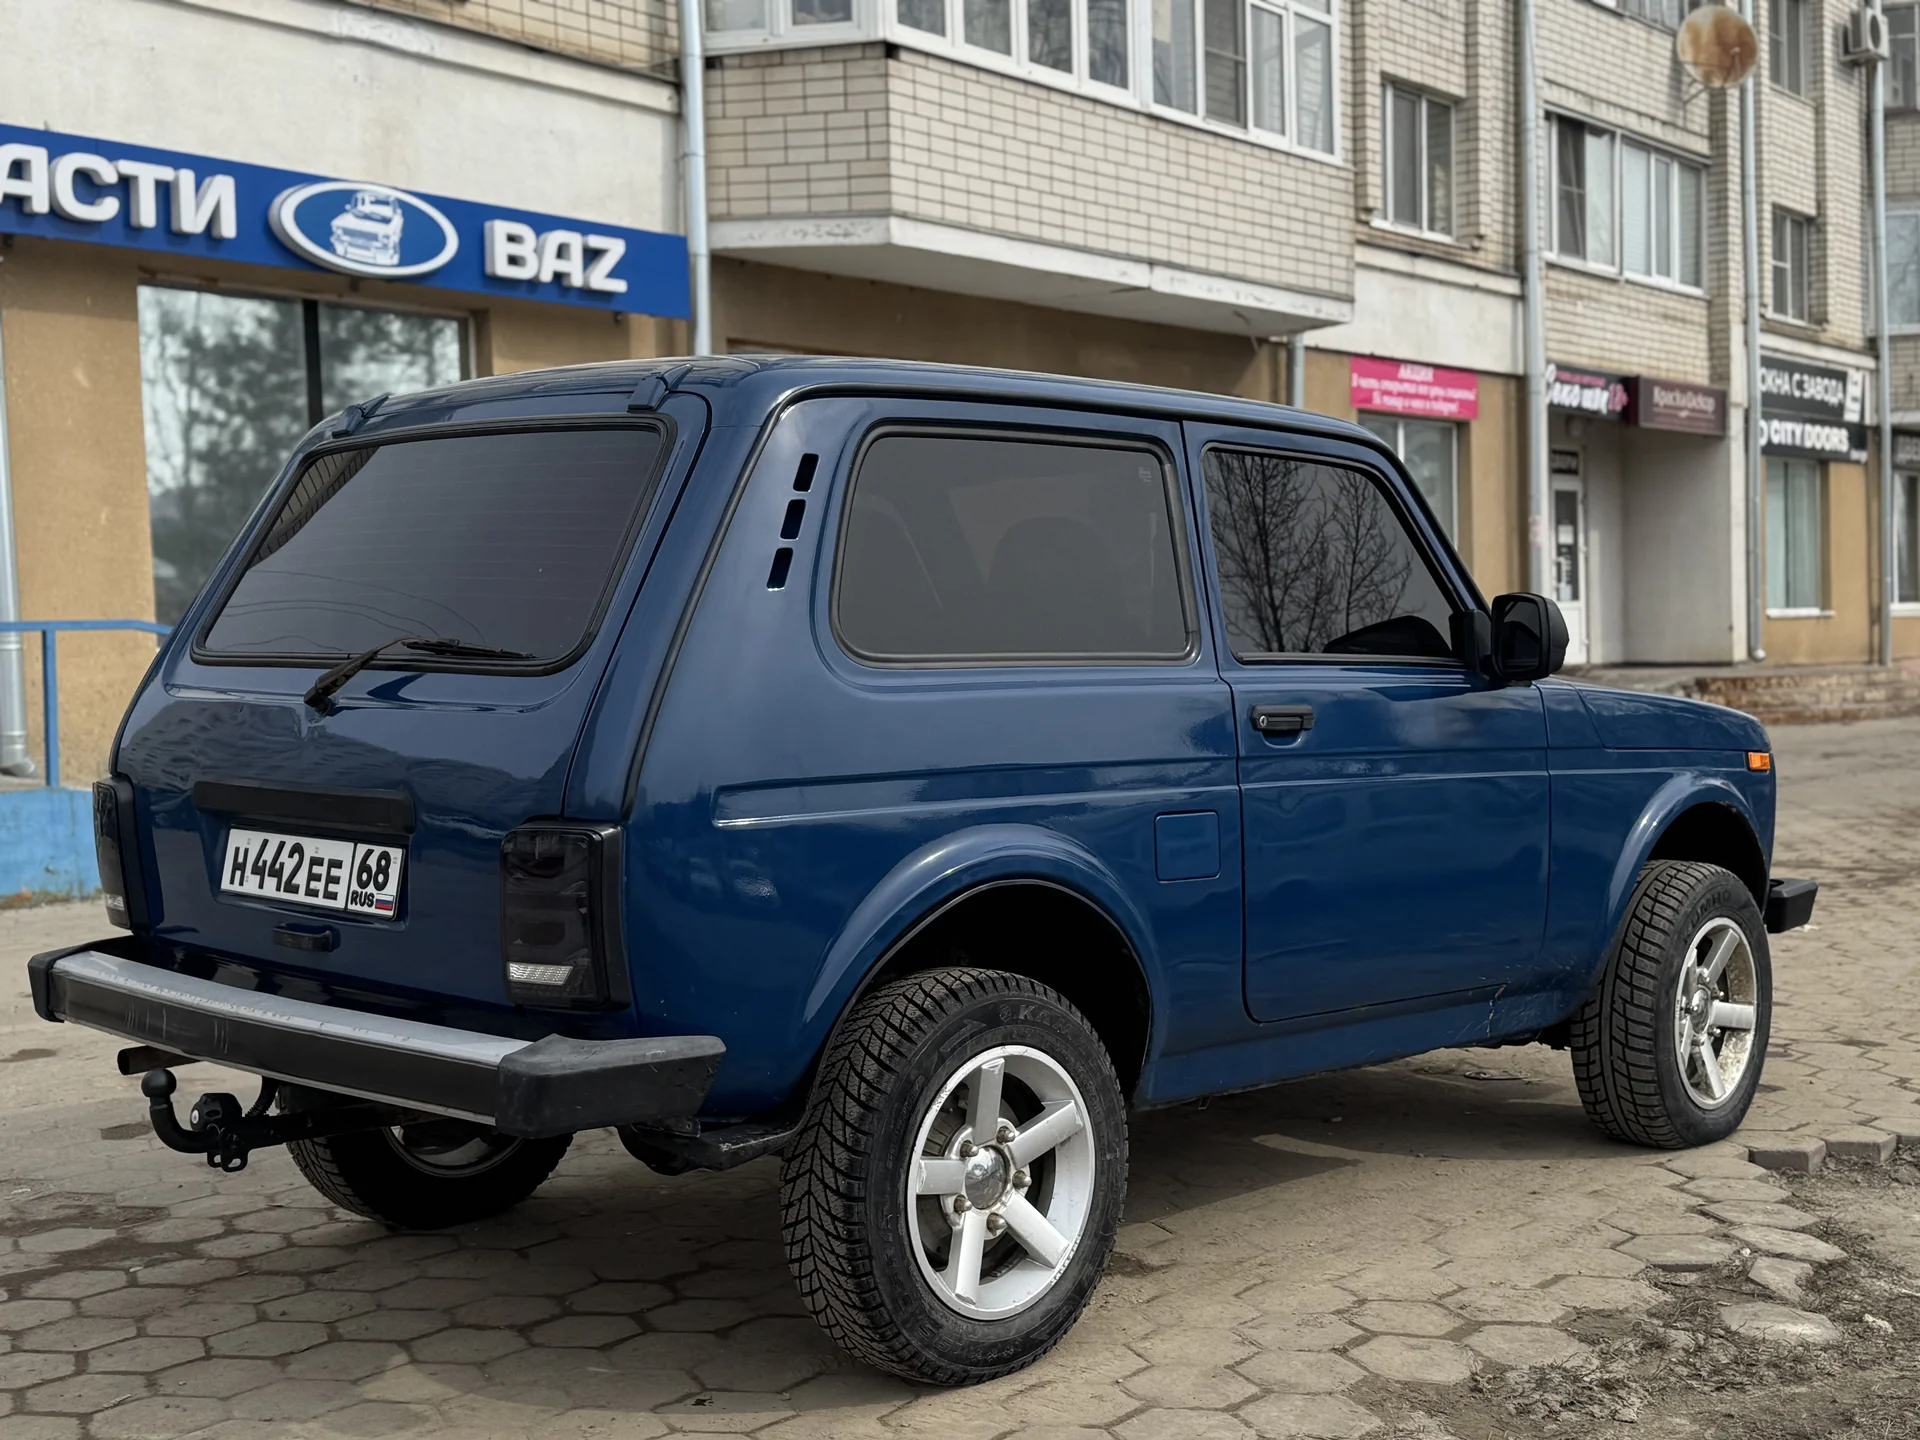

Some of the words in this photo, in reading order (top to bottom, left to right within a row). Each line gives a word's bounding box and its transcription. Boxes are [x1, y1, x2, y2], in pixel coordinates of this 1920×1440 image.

[1802, 374, 1845, 407] ЗАВОДА
[1770, 419, 1803, 446] CITY
[1804, 423, 1849, 452] DOORS
[356, 849, 392, 891] 68
[350, 889, 375, 908] RUS
